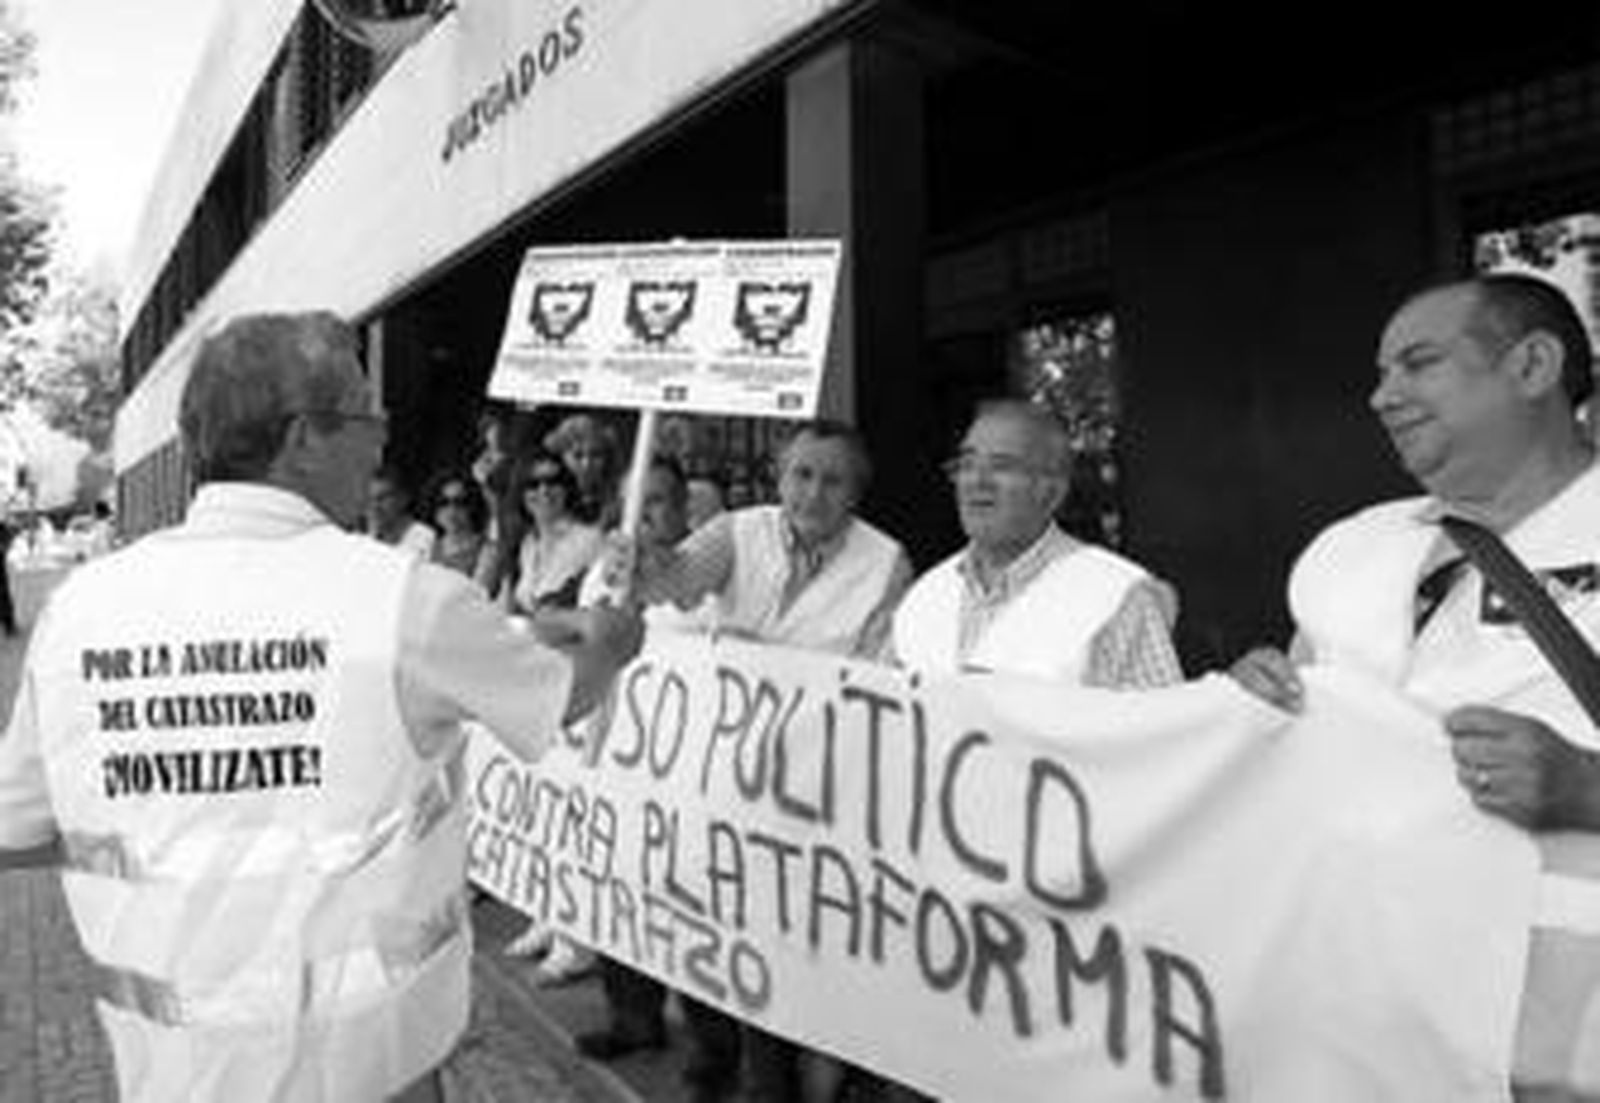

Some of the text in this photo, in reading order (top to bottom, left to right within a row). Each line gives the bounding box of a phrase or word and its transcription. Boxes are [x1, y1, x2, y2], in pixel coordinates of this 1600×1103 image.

[82, 647, 134, 682] POR
[145, 690, 315, 730] CATASTRAZO
[642, 799, 1224, 1099] PLATAFORMA
